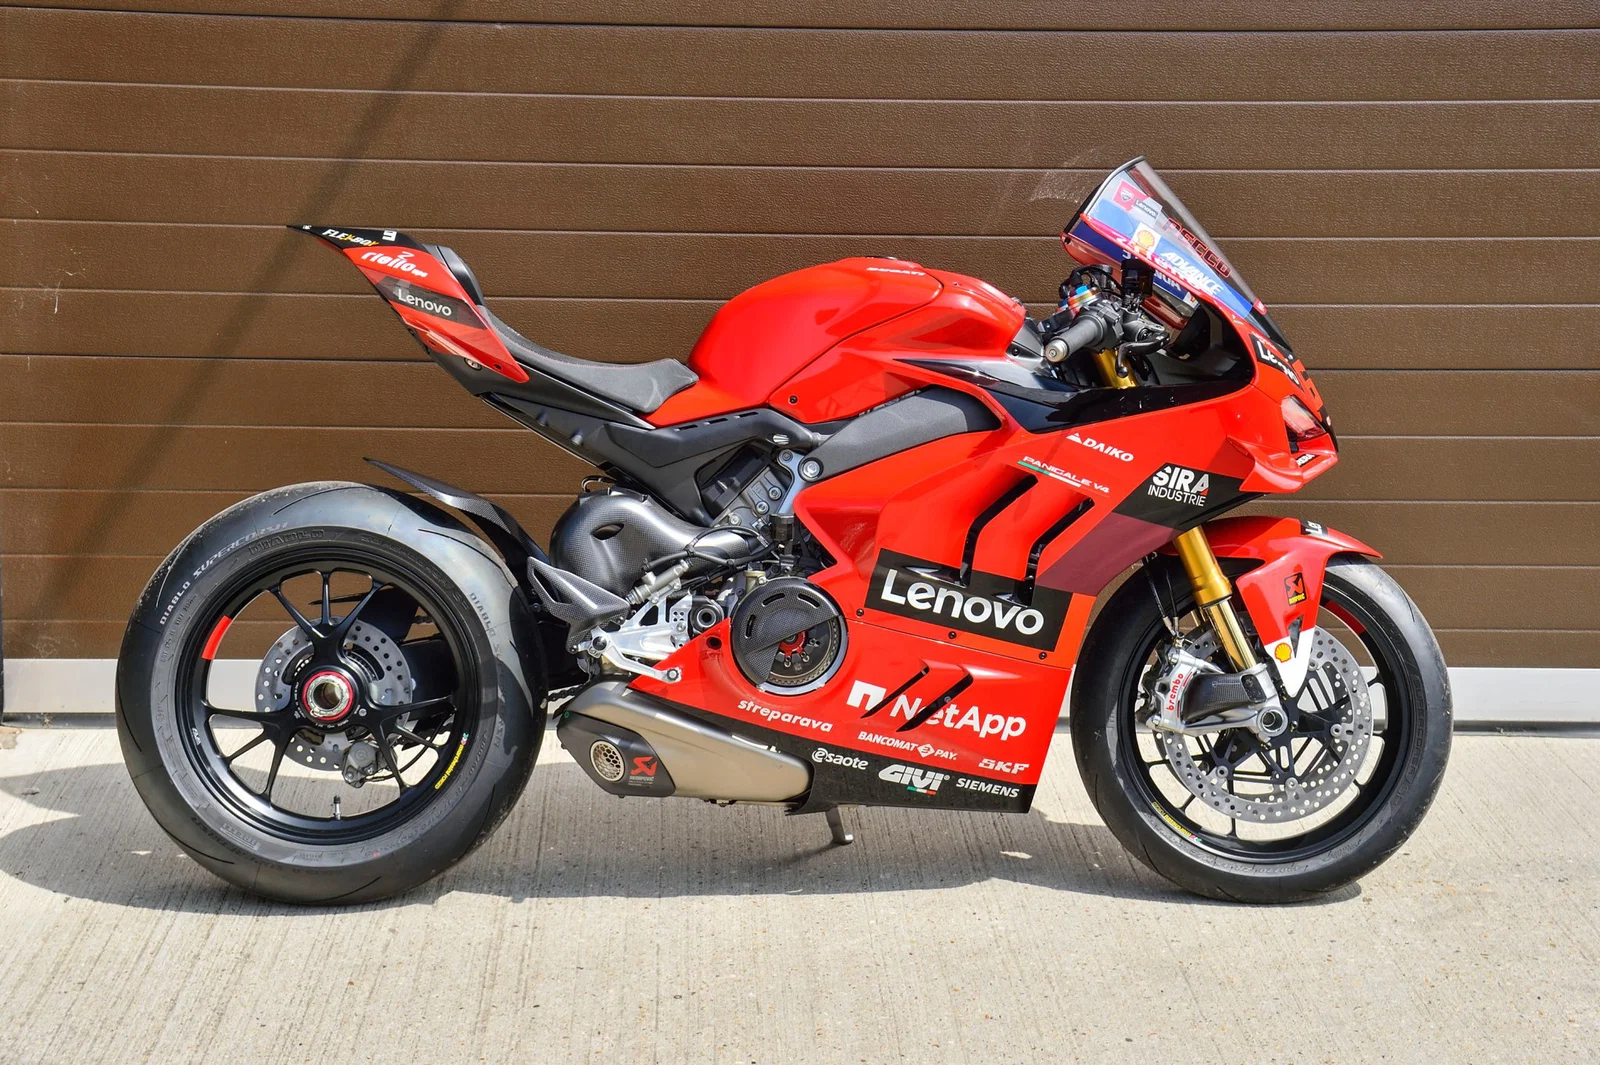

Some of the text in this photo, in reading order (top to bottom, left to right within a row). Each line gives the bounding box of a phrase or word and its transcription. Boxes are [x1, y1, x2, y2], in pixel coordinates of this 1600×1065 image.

[1160, 251, 1224, 295] ADVANCE
[398, 288, 452, 316] Lenovo
[1081, 438, 1134, 462] DAIKO
[1023, 456, 1110, 494] PANIGALE V4
[1152, 466, 1209, 496] SIRA
[1147, 485, 1207, 507] INDUSTRIE
[158, 578, 191, 626] DIABLO
[880, 569, 1044, 635] Lenovo
[1166, 673, 1184, 711] brembo
[737, 699, 834, 733] streparava
[889, 694, 1027, 741] NetApp
[858, 730, 918, 752] BANCOMAT
[878, 763, 945, 791] GIVI
[978, 758, 1030, 774] SKF
[955, 777, 1020, 798] SIEMENS
